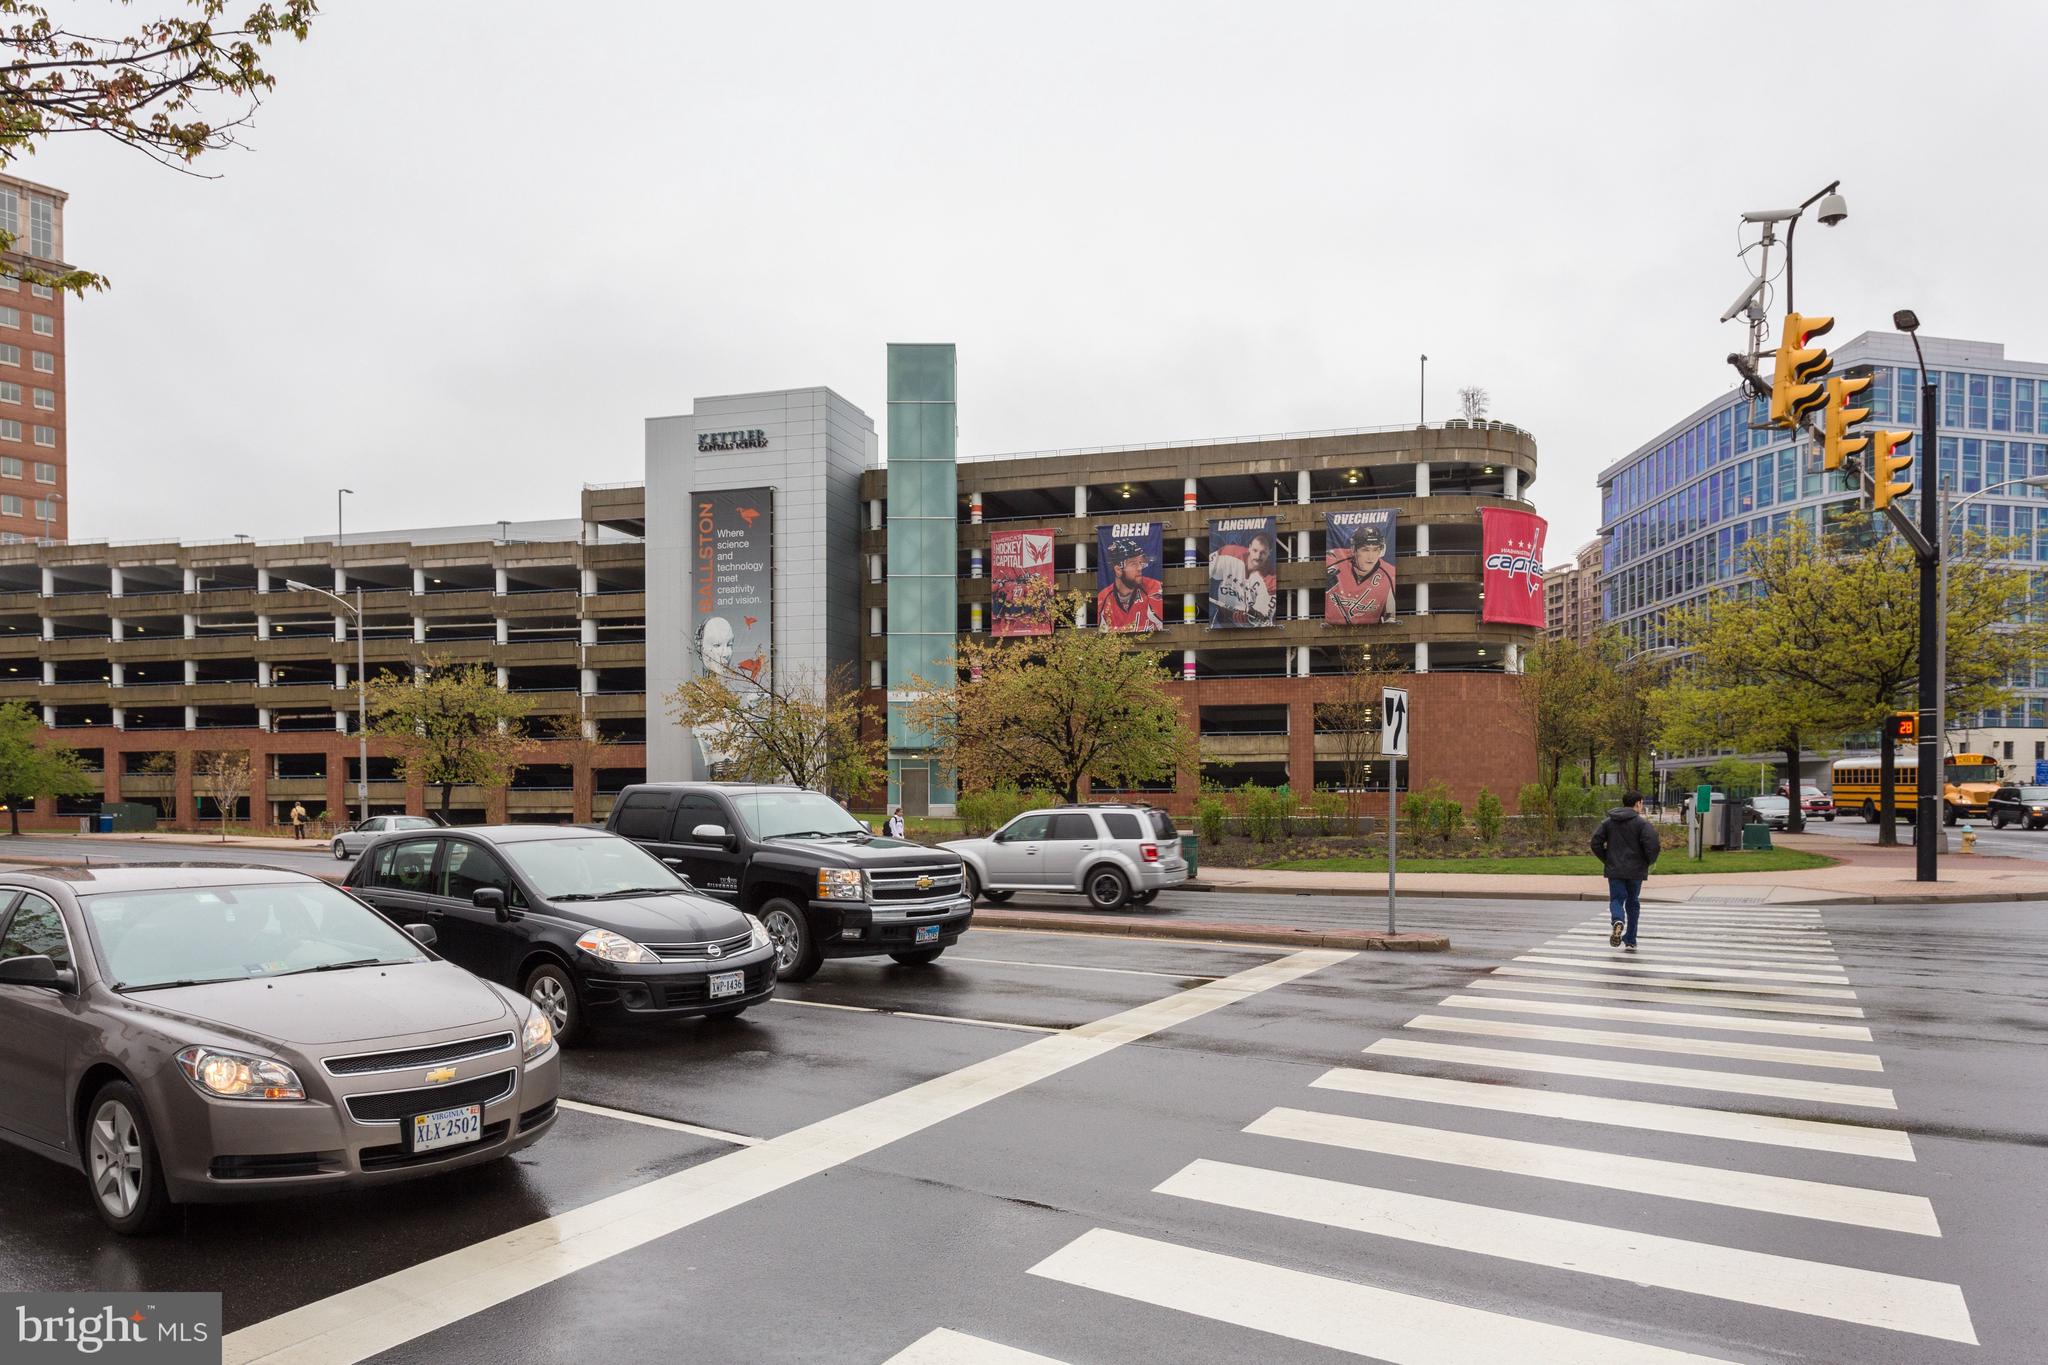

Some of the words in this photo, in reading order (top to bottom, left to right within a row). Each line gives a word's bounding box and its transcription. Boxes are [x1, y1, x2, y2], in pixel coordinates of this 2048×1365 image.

[698, 429, 765, 444] KETTLER
[698, 442, 734, 452] CAPITALS
[736, 438, 768, 449] ICEPLEX
[1217, 518, 1267, 531] LANGWAY
[1333, 512, 1388, 525] OVECHKIN
[717, 529, 744, 538] Where
[1112, 523, 1150, 538] GREEN
[717, 541, 750, 550] science
[995, 540, 1022, 555] HOCKEY
[699, 503, 713, 614] BALLSTON
[717, 552, 734, 561] and
[995, 554, 1023, 569] CAPITAL
[717, 562, 764, 571] technology
[717, 574, 738, 583] meet
[717, 585, 755, 594] creativity
[717, 597, 733, 606] and
[735, 596, 762, 605] vision.
[1900, 721, 1913, 734] 28
[432, 1110, 465, 1120] VIRGINIA
[417, 1115, 478, 1143] XLX-2502
